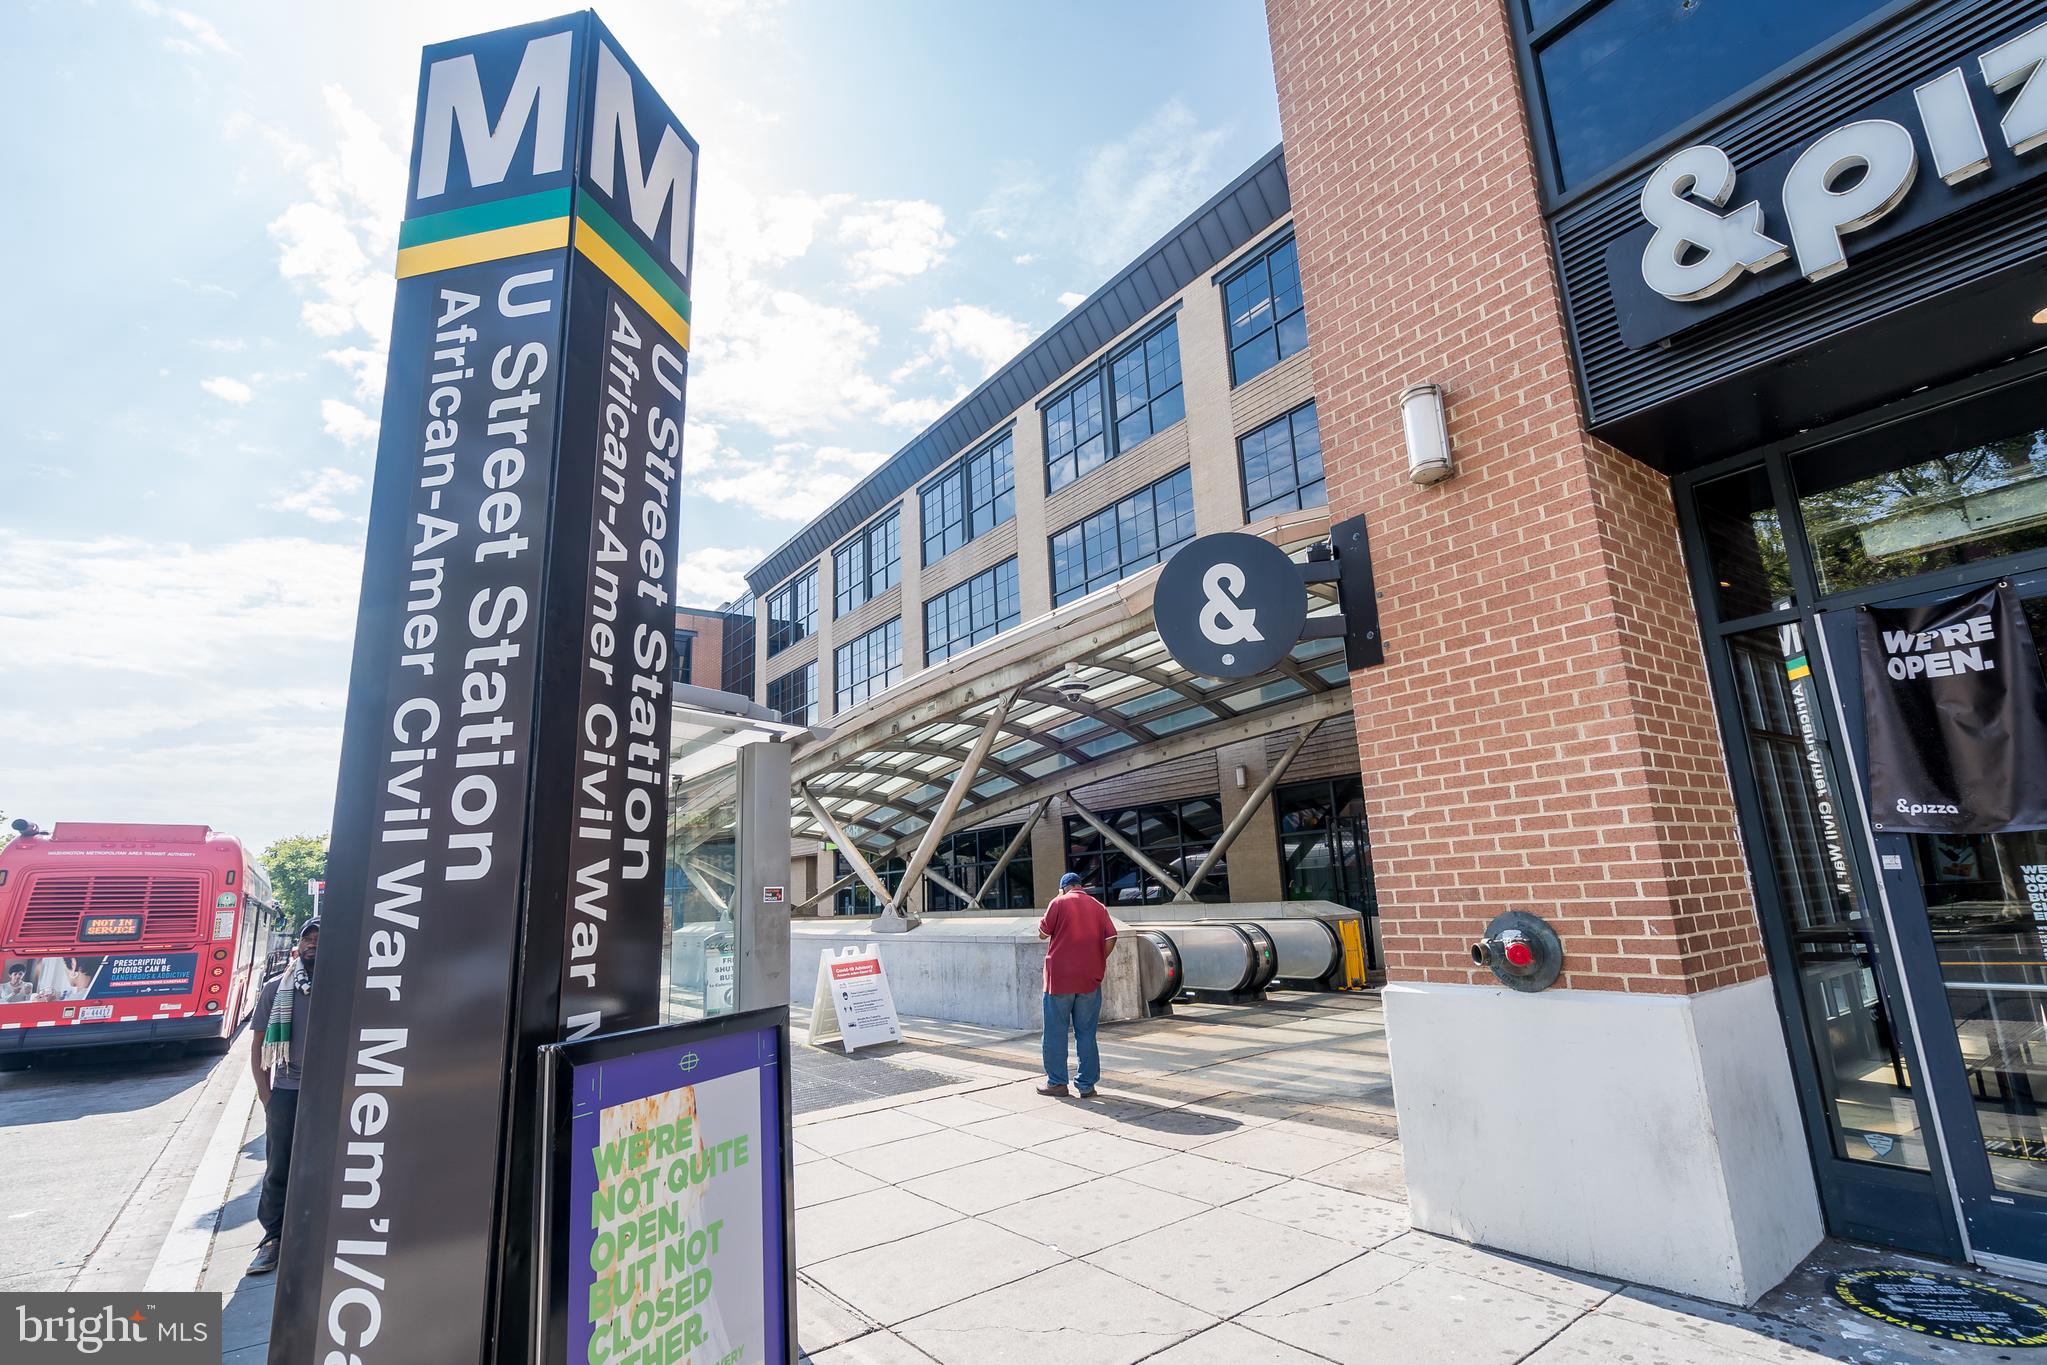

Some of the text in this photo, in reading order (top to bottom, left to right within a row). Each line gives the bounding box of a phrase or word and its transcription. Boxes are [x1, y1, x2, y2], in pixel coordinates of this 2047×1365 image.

[416, 31, 573, 200] M
[590, 39, 694, 278] M
[401, 288, 481, 676] African-Amer
[589, 301, 642, 686] African-Amer
[445, 269, 554, 881] U Street Station
[622, 344, 684, 880] U Street Station
[1882, 615, 1995, 653] WE'RE
[1887, 646, 1995, 680] OPEN.
[382, 697, 441, 842] Civil
[578, 703, 618, 841] Civil
[1896, 798, 1959, 816] &pizza
[88, 926, 136, 935] SERVICE
[92, 919, 116, 927] NOT
[112, 964, 171, 975] OPIOIDS CAN BE
[113, 957, 167, 967] PRESCRIPTION
[366, 860, 425, 1001] War
[570, 858, 610, 988] War
[111, 973, 151, 981] DANGEROUS
[157, 971, 190, 979] ADDICTIVE
[592, 1117, 693, 1180] WE'RE
[592, 1135, 749, 1229] NOT QUITE
[588, 1219, 724, 1323] BUT NOT
[589, 1200, 686, 1272] OPEN,
[587, 1267, 713, 1365] CLOSED
